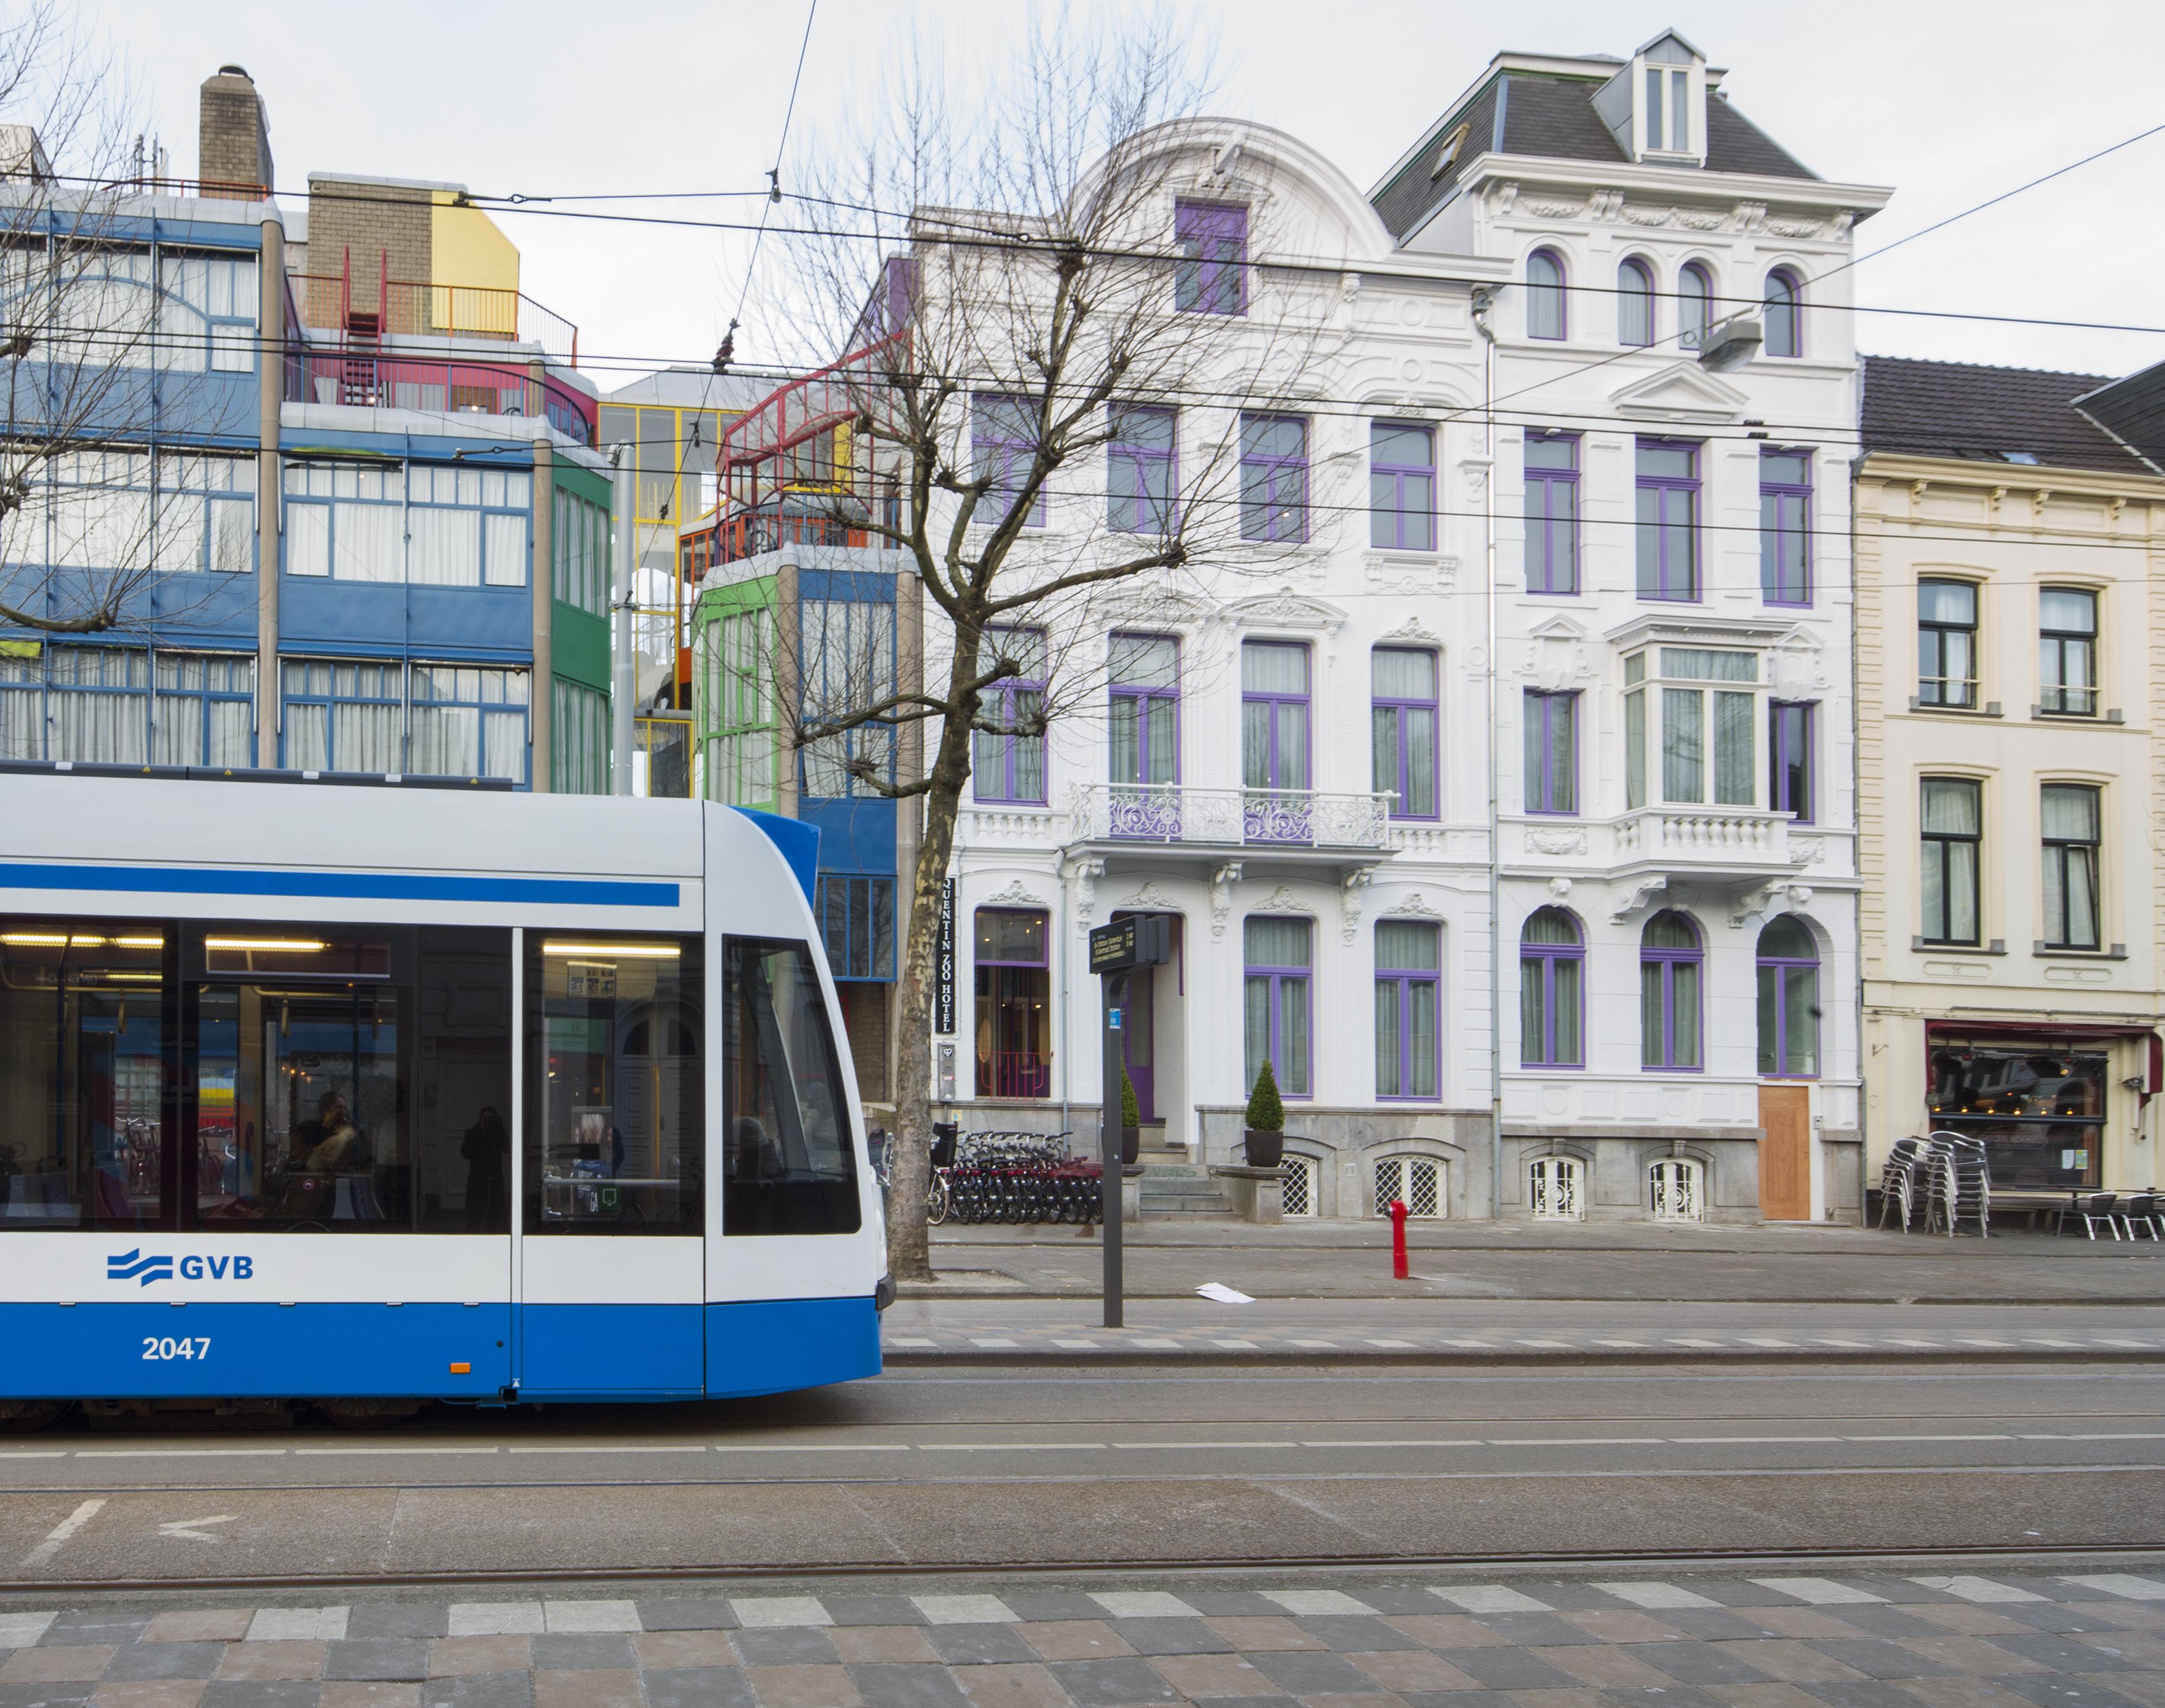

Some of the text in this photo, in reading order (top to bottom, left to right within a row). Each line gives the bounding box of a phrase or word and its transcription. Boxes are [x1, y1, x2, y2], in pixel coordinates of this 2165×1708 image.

[942, 878, 951, 1032] QUENTIN ZOO HOTEL
[180, 1255, 253, 1280] GVB
[142, 1337, 211, 1360] 2047
